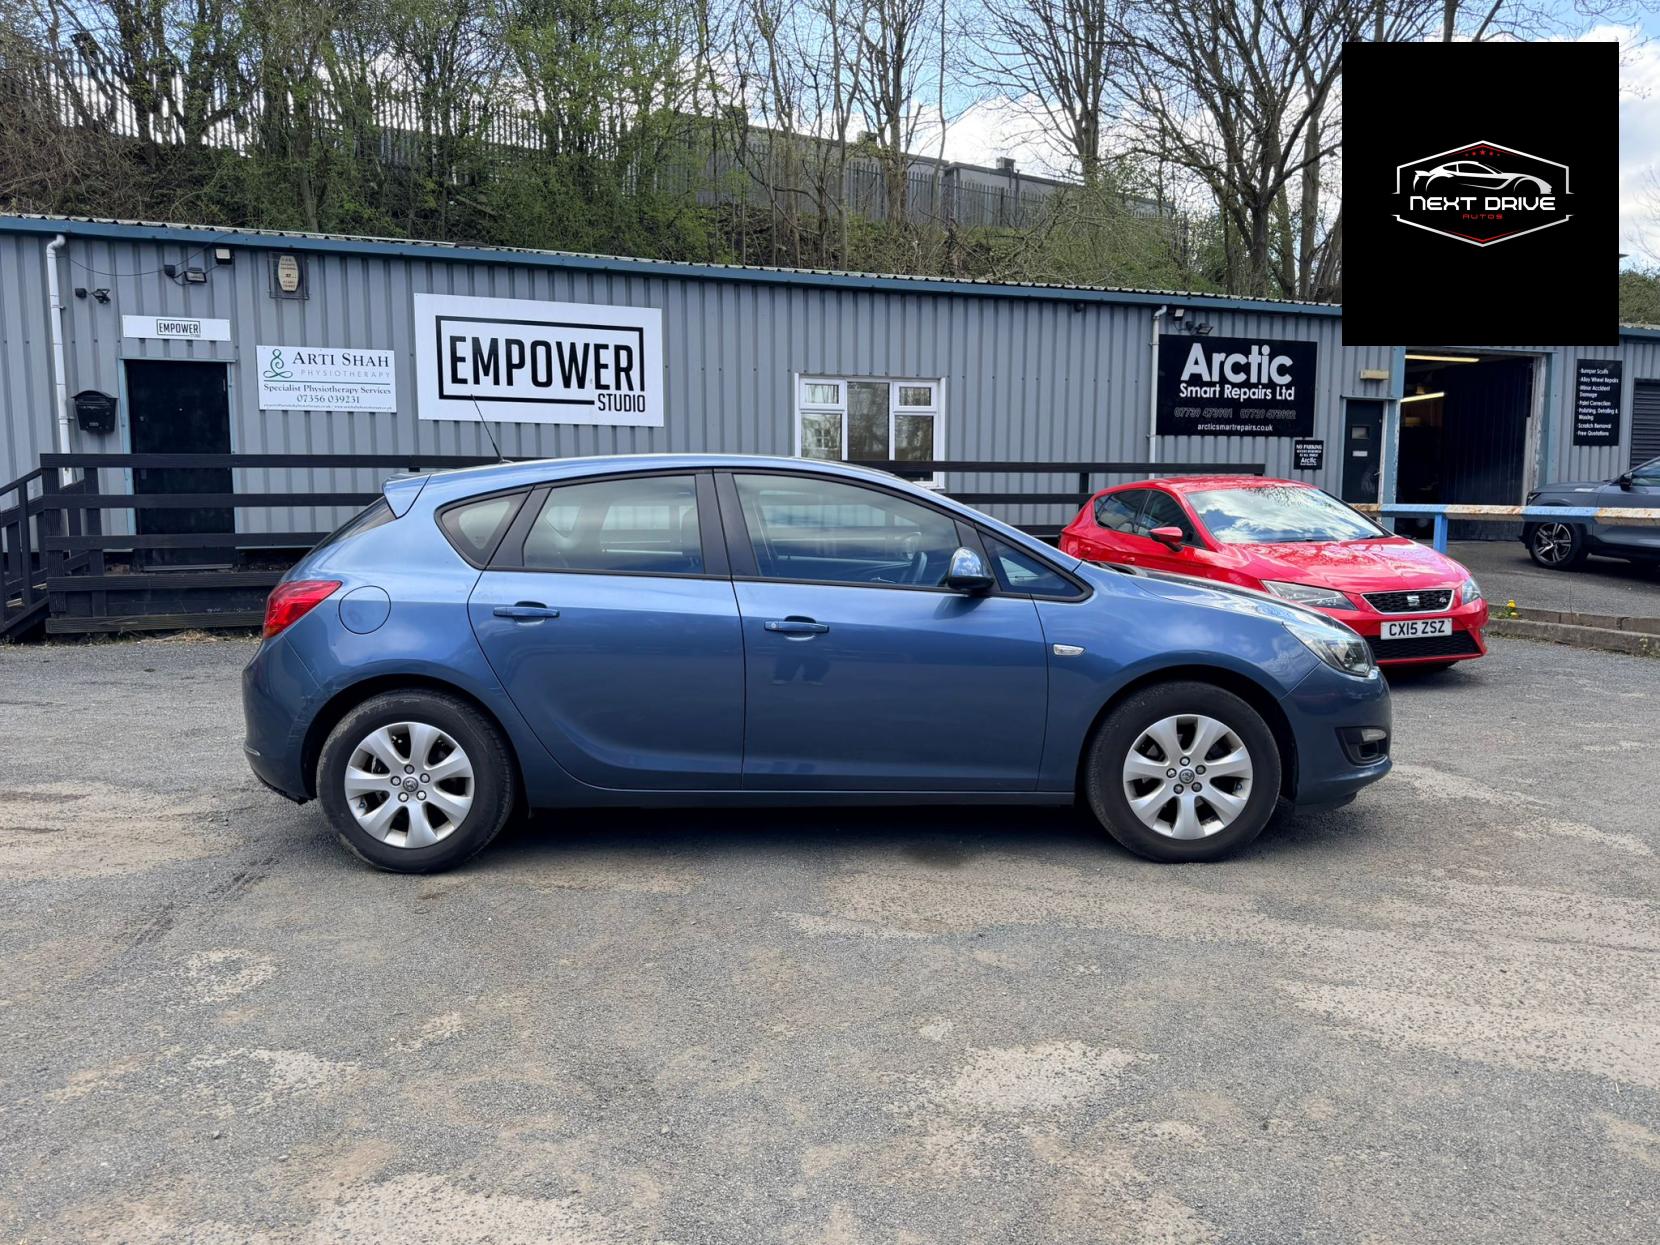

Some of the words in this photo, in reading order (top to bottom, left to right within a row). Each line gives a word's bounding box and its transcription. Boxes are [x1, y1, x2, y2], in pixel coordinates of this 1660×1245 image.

[159, 322, 199, 334] EMPOWER
[293, 351, 335, 366] ARTI
[342, 352, 390, 368] SHAH
[450, 335, 634, 392] EMPOWER
[1180, 342, 1294, 385] Arctic
[301, 369, 390, 378] PHYSIOTHERAPY
[263, 384, 301, 393] Specialist
[303, 385, 359, 395] Physiotherapy
[360, 385, 391, 395] Services
[1179, 383, 1220, 398] Smart
[1224, 384, 1272, 402] Repairs
[1276, 386, 1295, 401] Ltd
[296, 394, 326, 403] 07356
[328, 395, 360, 404] 039231
[598, 393, 646, 413] STUDIO
[1197, 423, 1273, 432] arcticsmartrepairs.co.uk
[1389, 622, 1418, 637] CX15
[1421, 620, 1445, 635] ZSZ
